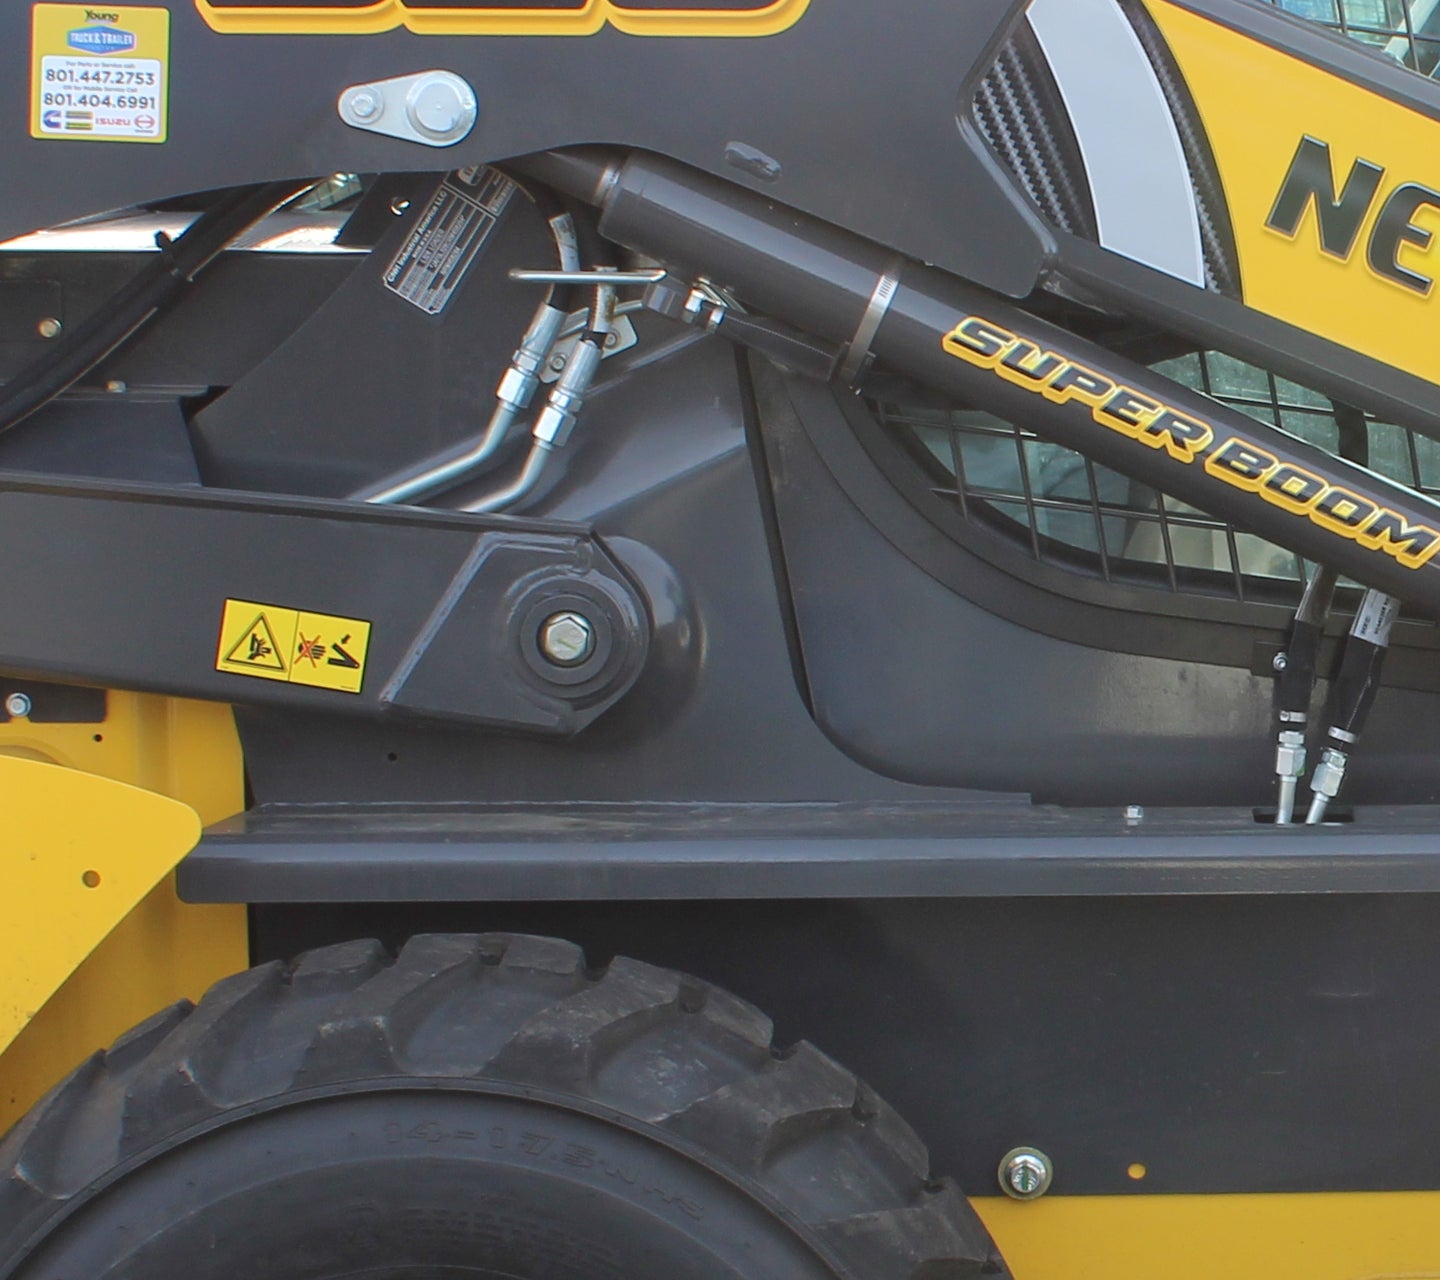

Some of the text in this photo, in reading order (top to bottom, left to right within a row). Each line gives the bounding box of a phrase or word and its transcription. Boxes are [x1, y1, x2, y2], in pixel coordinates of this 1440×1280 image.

[85, 10, 119, 23] Young
[101, 33, 133, 45] TRAILER
[45, 68, 155, 86] 801.447.2753
[44, 92, 156, 110] 801.404.6991
[95, 117, 131, 126] ISUZU
[415, 203, 439, 235] America
[942, 317, 1215, 464] SUPER
